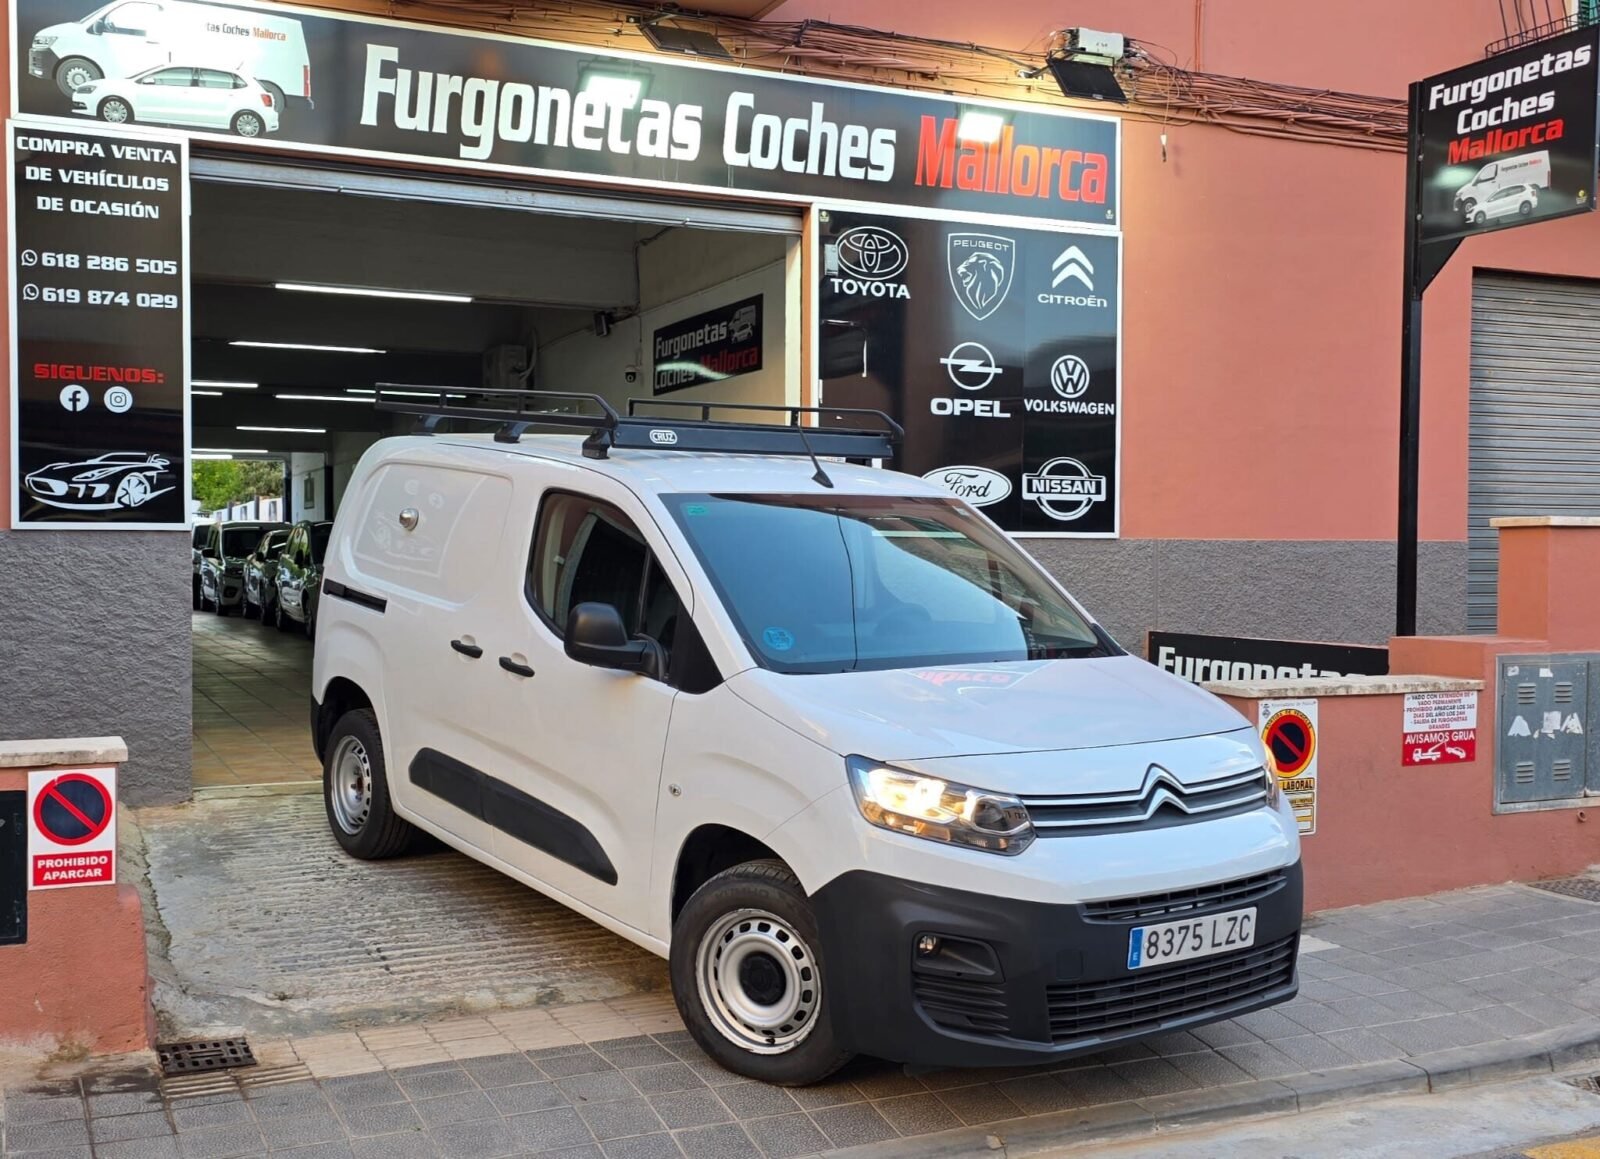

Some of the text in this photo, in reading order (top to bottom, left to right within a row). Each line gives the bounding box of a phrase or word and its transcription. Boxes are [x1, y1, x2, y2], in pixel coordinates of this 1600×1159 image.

[222, 23, 250, 36] Coches
[253, 27, 286, 41] Mallorca
[1428, 45, 1592, 111] Furgonetas
[360, 43, 1108, 204] Furgonetas Coches Mallorca
[1456, 90, 1556, 135] Coches
[16, 136, 177, 164] COMPRA VENTA
[1447, 118, 1565, 166] Mallorca
[25, 166, 169, 192] DE VEHÍCULOS
[36, 196, 160, 219] DE OCASIÓN
[953, 239, 1011, 252] PEUGEOT
[41, 252, 177, 275] 618 286 505
[42, 287, 178, 309] 619 874 029
[830, 277, 911, 300] TOYOTA
[655, 321, 728, 360] Furgonetas
[33, 363, 165, 384] SIGUENOS:
[930, 397, 1011, 418] OPEL
[1023, 398, 1115, 416] VOLKSWAGEN
[652, 432, 675, 442] CRUZ
[944, 473, 992, 499] Ford
[1031, 478, 1097, 494] NISSAN
[1404, 730, 1476, 745] AVISAMOS GRUA
[1282, 780, 1313, 791] LABORAL
[37, 855, 108, 869] PROHIBIDO
[43, 868, 103, 881] APARCAR
[1146, 923, 1203, 960] 8375
[1211, 914, 1251, 949] LZC
